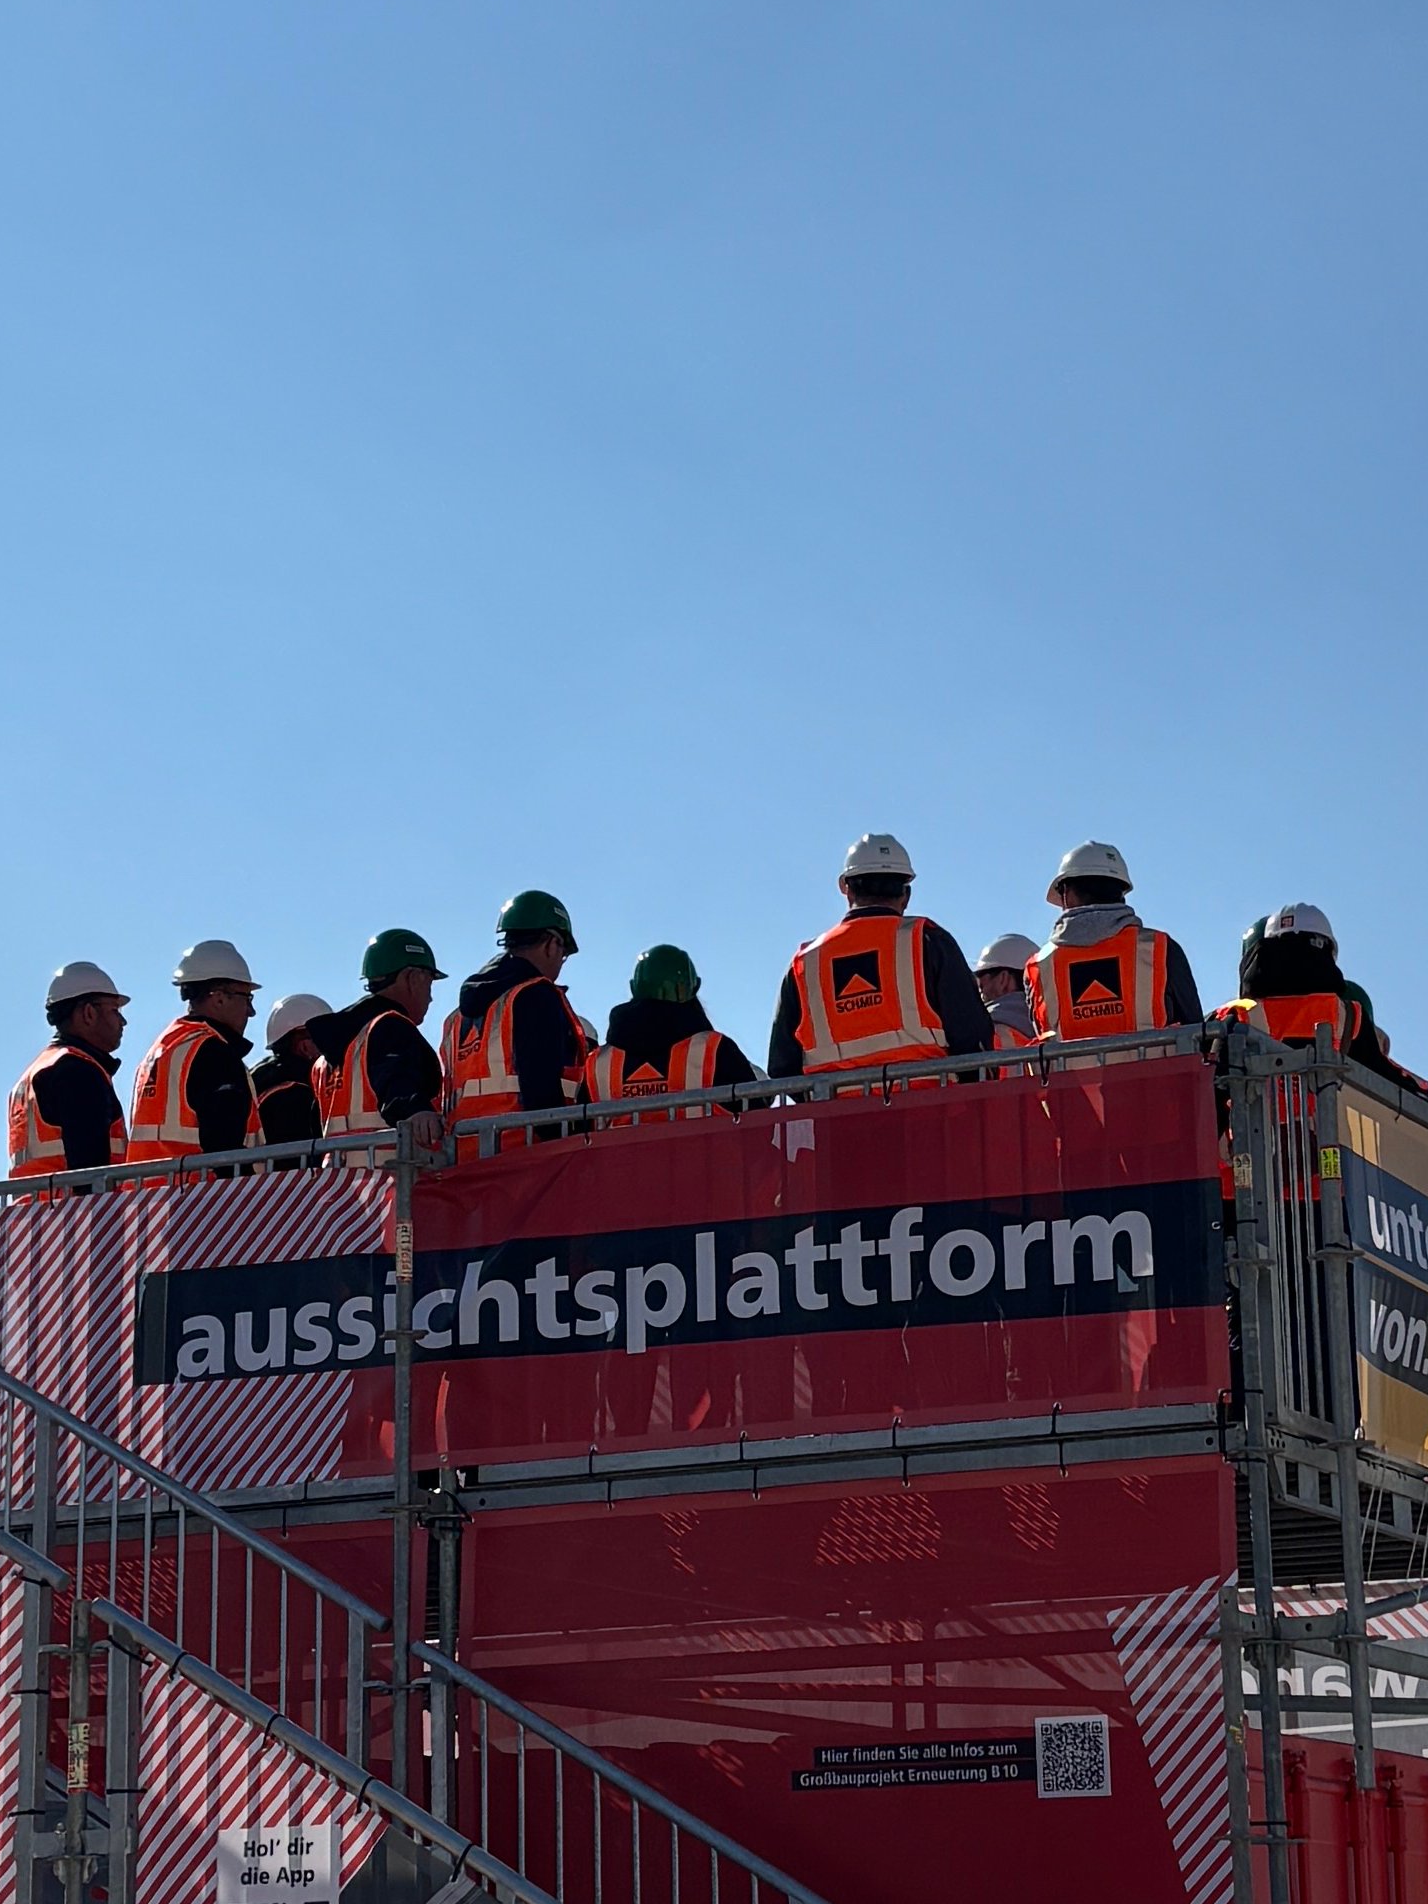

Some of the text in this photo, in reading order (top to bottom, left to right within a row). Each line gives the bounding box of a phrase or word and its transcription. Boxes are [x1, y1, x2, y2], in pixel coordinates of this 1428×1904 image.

[835, 995, 883, 1014] SCHMID
[1073, 1002, 1124, 1020] SCHMID
[622, 1082, 669, 1098] SCHMID
[176, 1206, 1154, 1380] aussichtsplattform
[822, 1742, 1018, 1765] Hier finden Sie alle Infos zum
[799, 1769, 905, 1788] Großbauprojekt
[908, 1766, 988, 1783] Erneuerung
[287, 1837, 314, 1856] dir
[240, 1866, 315, 1888] die App
